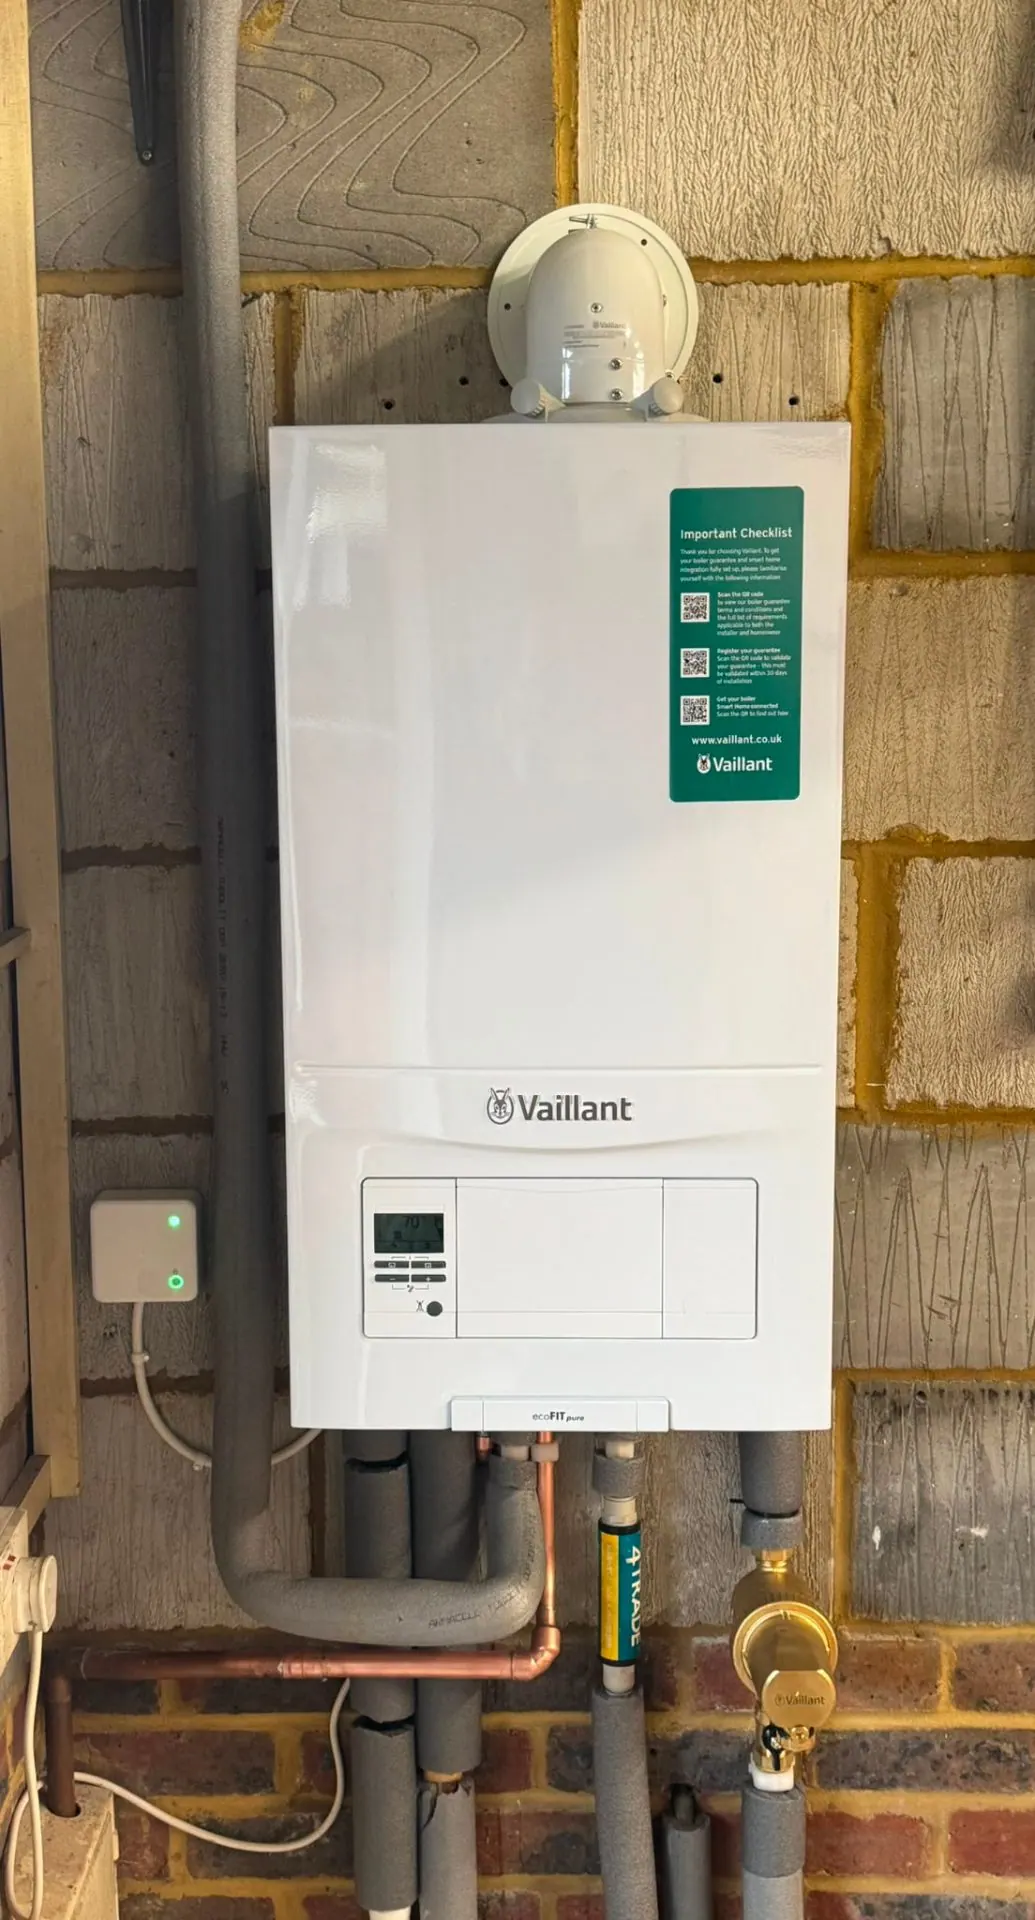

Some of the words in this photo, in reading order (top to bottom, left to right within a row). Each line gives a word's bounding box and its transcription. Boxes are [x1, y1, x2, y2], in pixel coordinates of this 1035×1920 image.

[680, 528, 737, 541] Important
[740, 527, 793, 539] Checklist
[692, 734, 782, 745] www.vaillant.co.uk
[713, 756, 773, 772] Vaillant
[517, 1094, 632, 1121] Vaillant
[532, 1411, 566, 1421] ecoFIT
[785, 1695, 825, 1705] Vaillant
